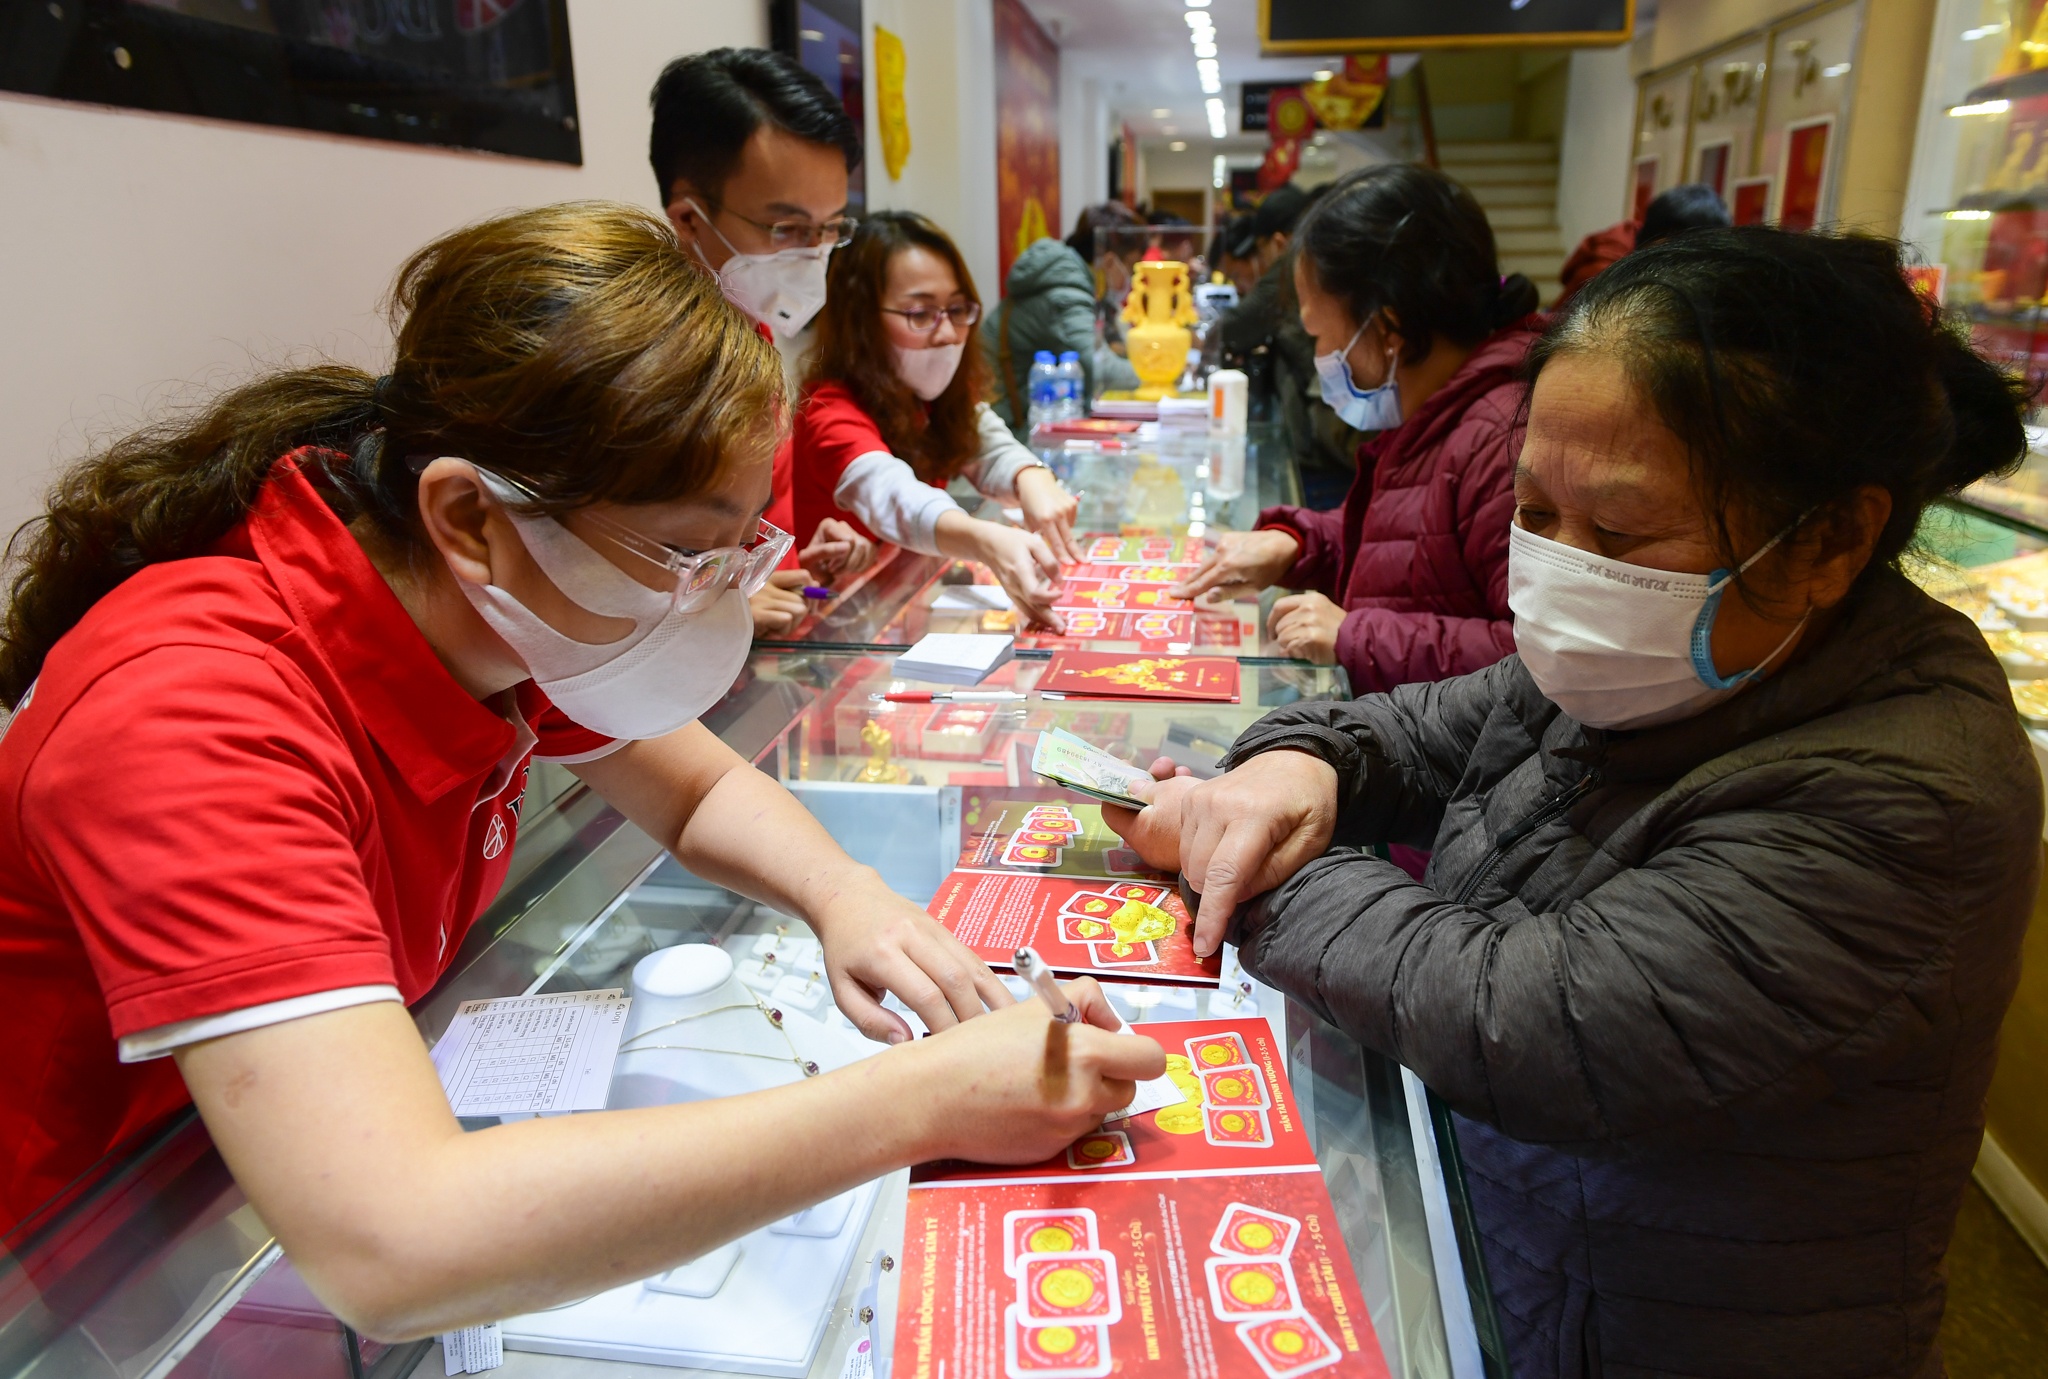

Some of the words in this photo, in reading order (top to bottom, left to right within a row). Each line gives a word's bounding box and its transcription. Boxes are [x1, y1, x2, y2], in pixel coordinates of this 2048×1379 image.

[1277, 1103, 1287, 1114] TÀI
[925, 1231, 937, 1252] KIM
[1146, 1337, 1159, 1360] KIM
[1343, 1329, 1359, 1351] KIM
